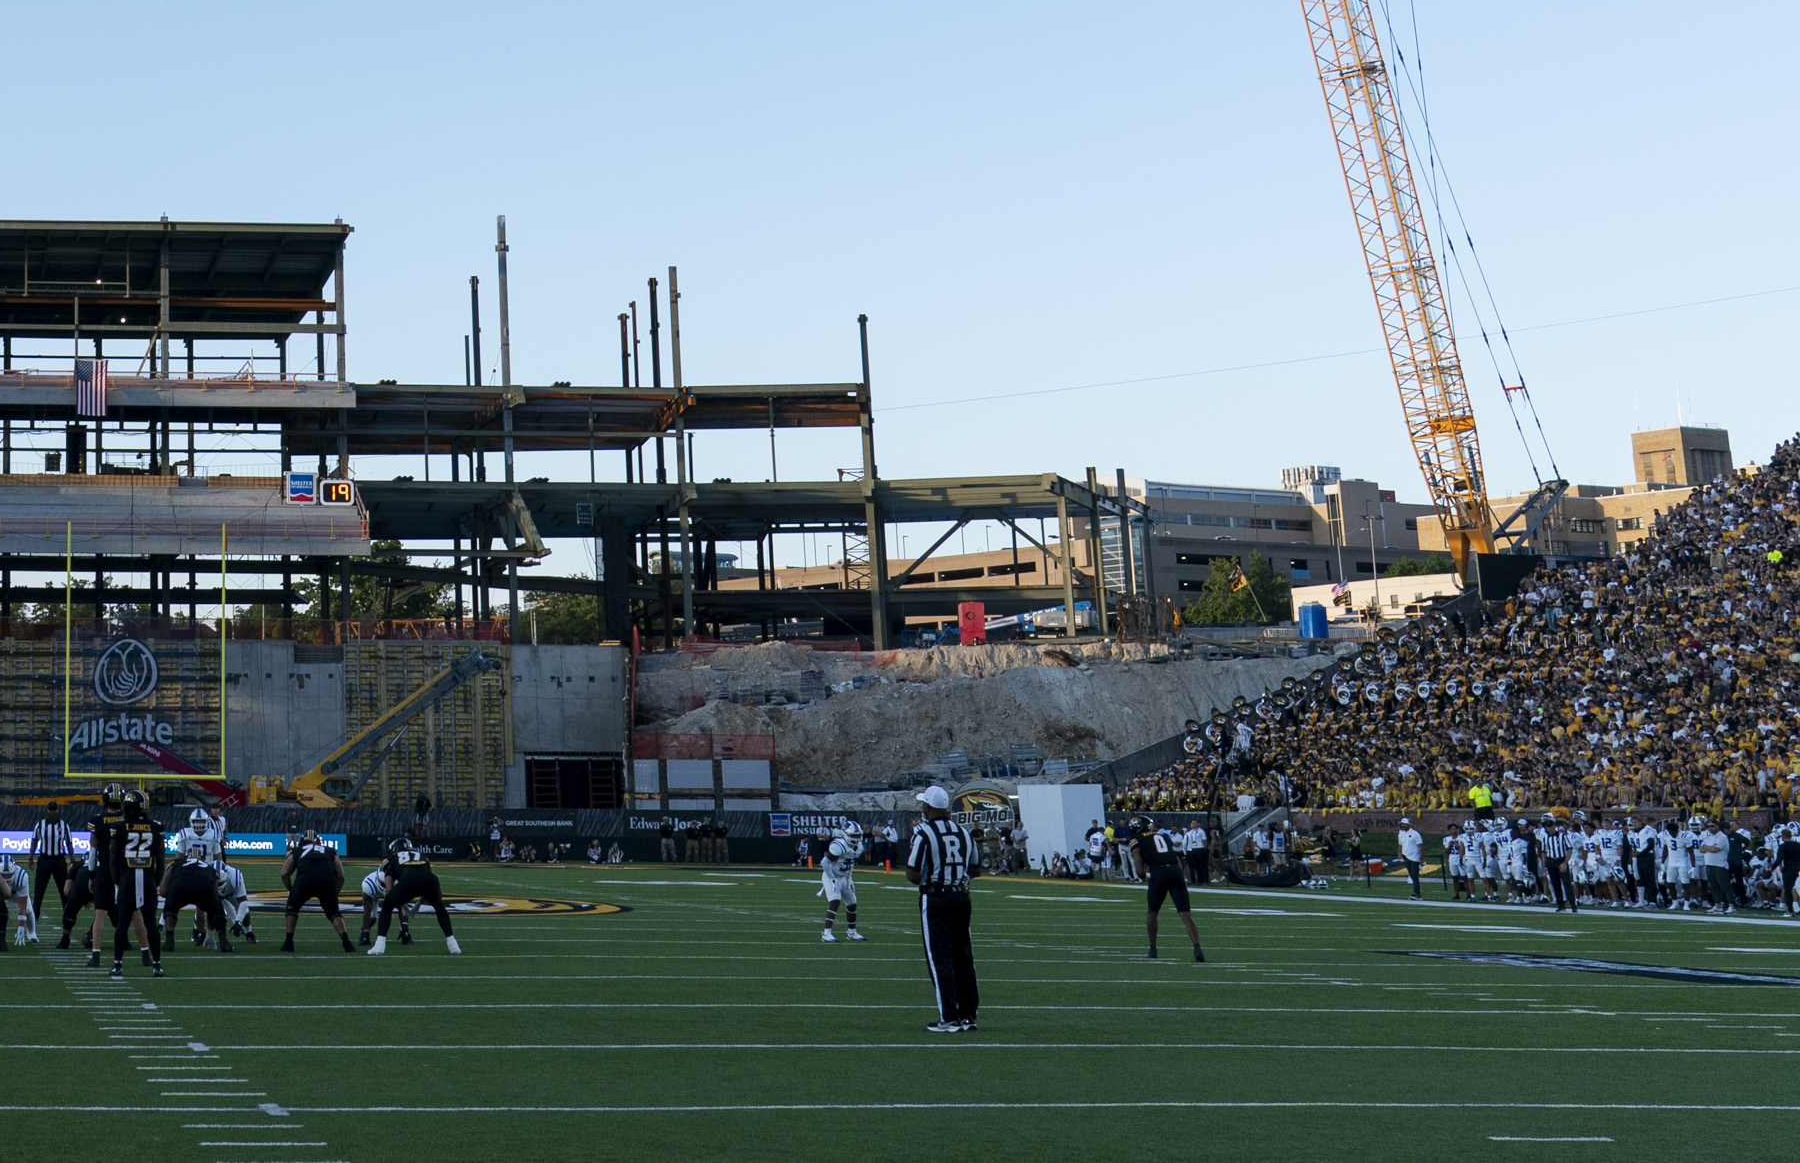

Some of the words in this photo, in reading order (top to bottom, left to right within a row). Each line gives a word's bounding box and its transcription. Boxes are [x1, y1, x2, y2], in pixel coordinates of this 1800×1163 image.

[332, 484, 349, 501] 19
[68, 712, 173, 750] Allstate
[140, 742, 161, 758] MAGNI
[957, 812, 980, 824] BIG
[986, 810, 1008, 822] MO
[132, 824, 151, 832] JONES
[1376, 820, 1400, 828] PINKE
[125, 832, 153, 858] 22
[1153, 834, 1168, 853] 0
[1467, 841, 1474, 851] 2
[1496, 837, 1508, 847] 44
[1601, 837, 1612, 849] 12
[1670, 840, 1677, 850] 3
[433, 845, 453, 855] Care
[943, 835, 963, 863] R
[397, 851, 421, 864] 87
